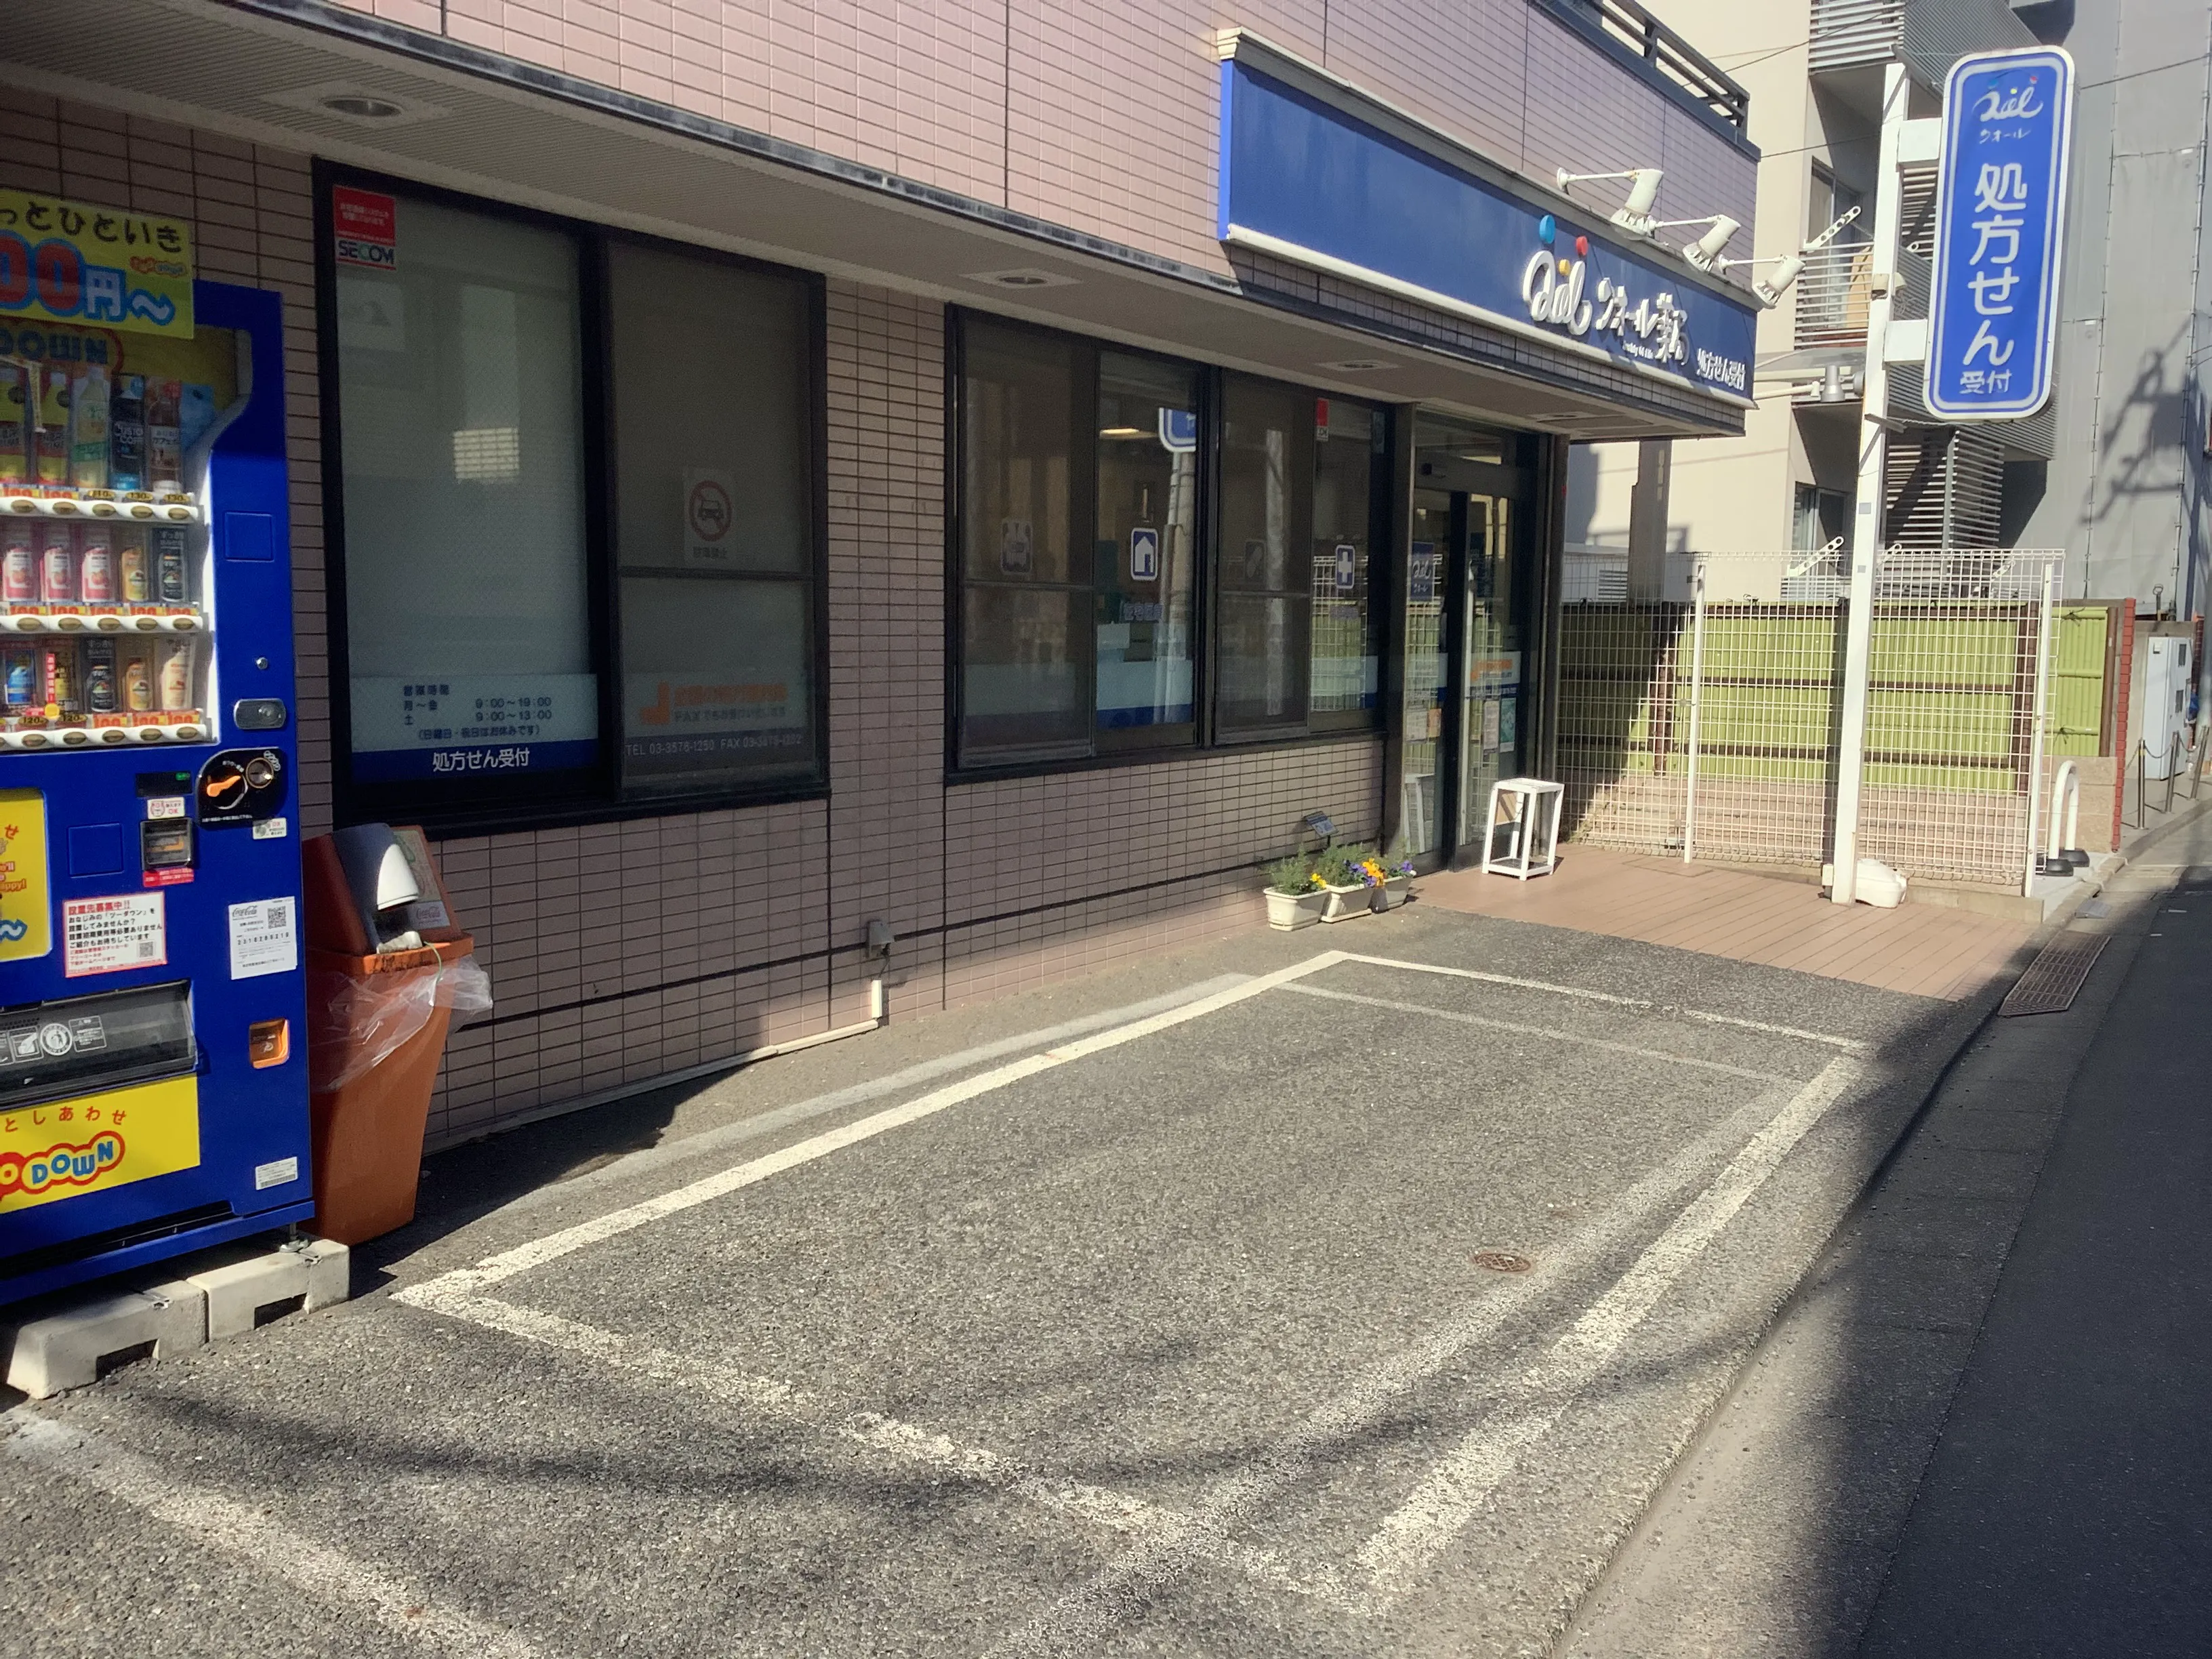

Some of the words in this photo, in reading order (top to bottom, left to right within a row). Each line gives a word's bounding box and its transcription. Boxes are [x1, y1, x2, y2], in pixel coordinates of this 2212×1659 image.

[1979, 128, 2031, 144] クオール
[339, 239, 394, 265] SECOM
[1963, 163, 2028, 366] 処方せん
[1959, 369, 2012, 395] 受付
[405, 715, 414, 726] 土
[432, 747, 530, 773] 処方せん受付
[626, 743, 646, 756] TEL
[720, 738, 740, 750] FAX
[5, 1106, 127, 1133] としあわせ
[31, 1141, 114, 1185] DOWN
